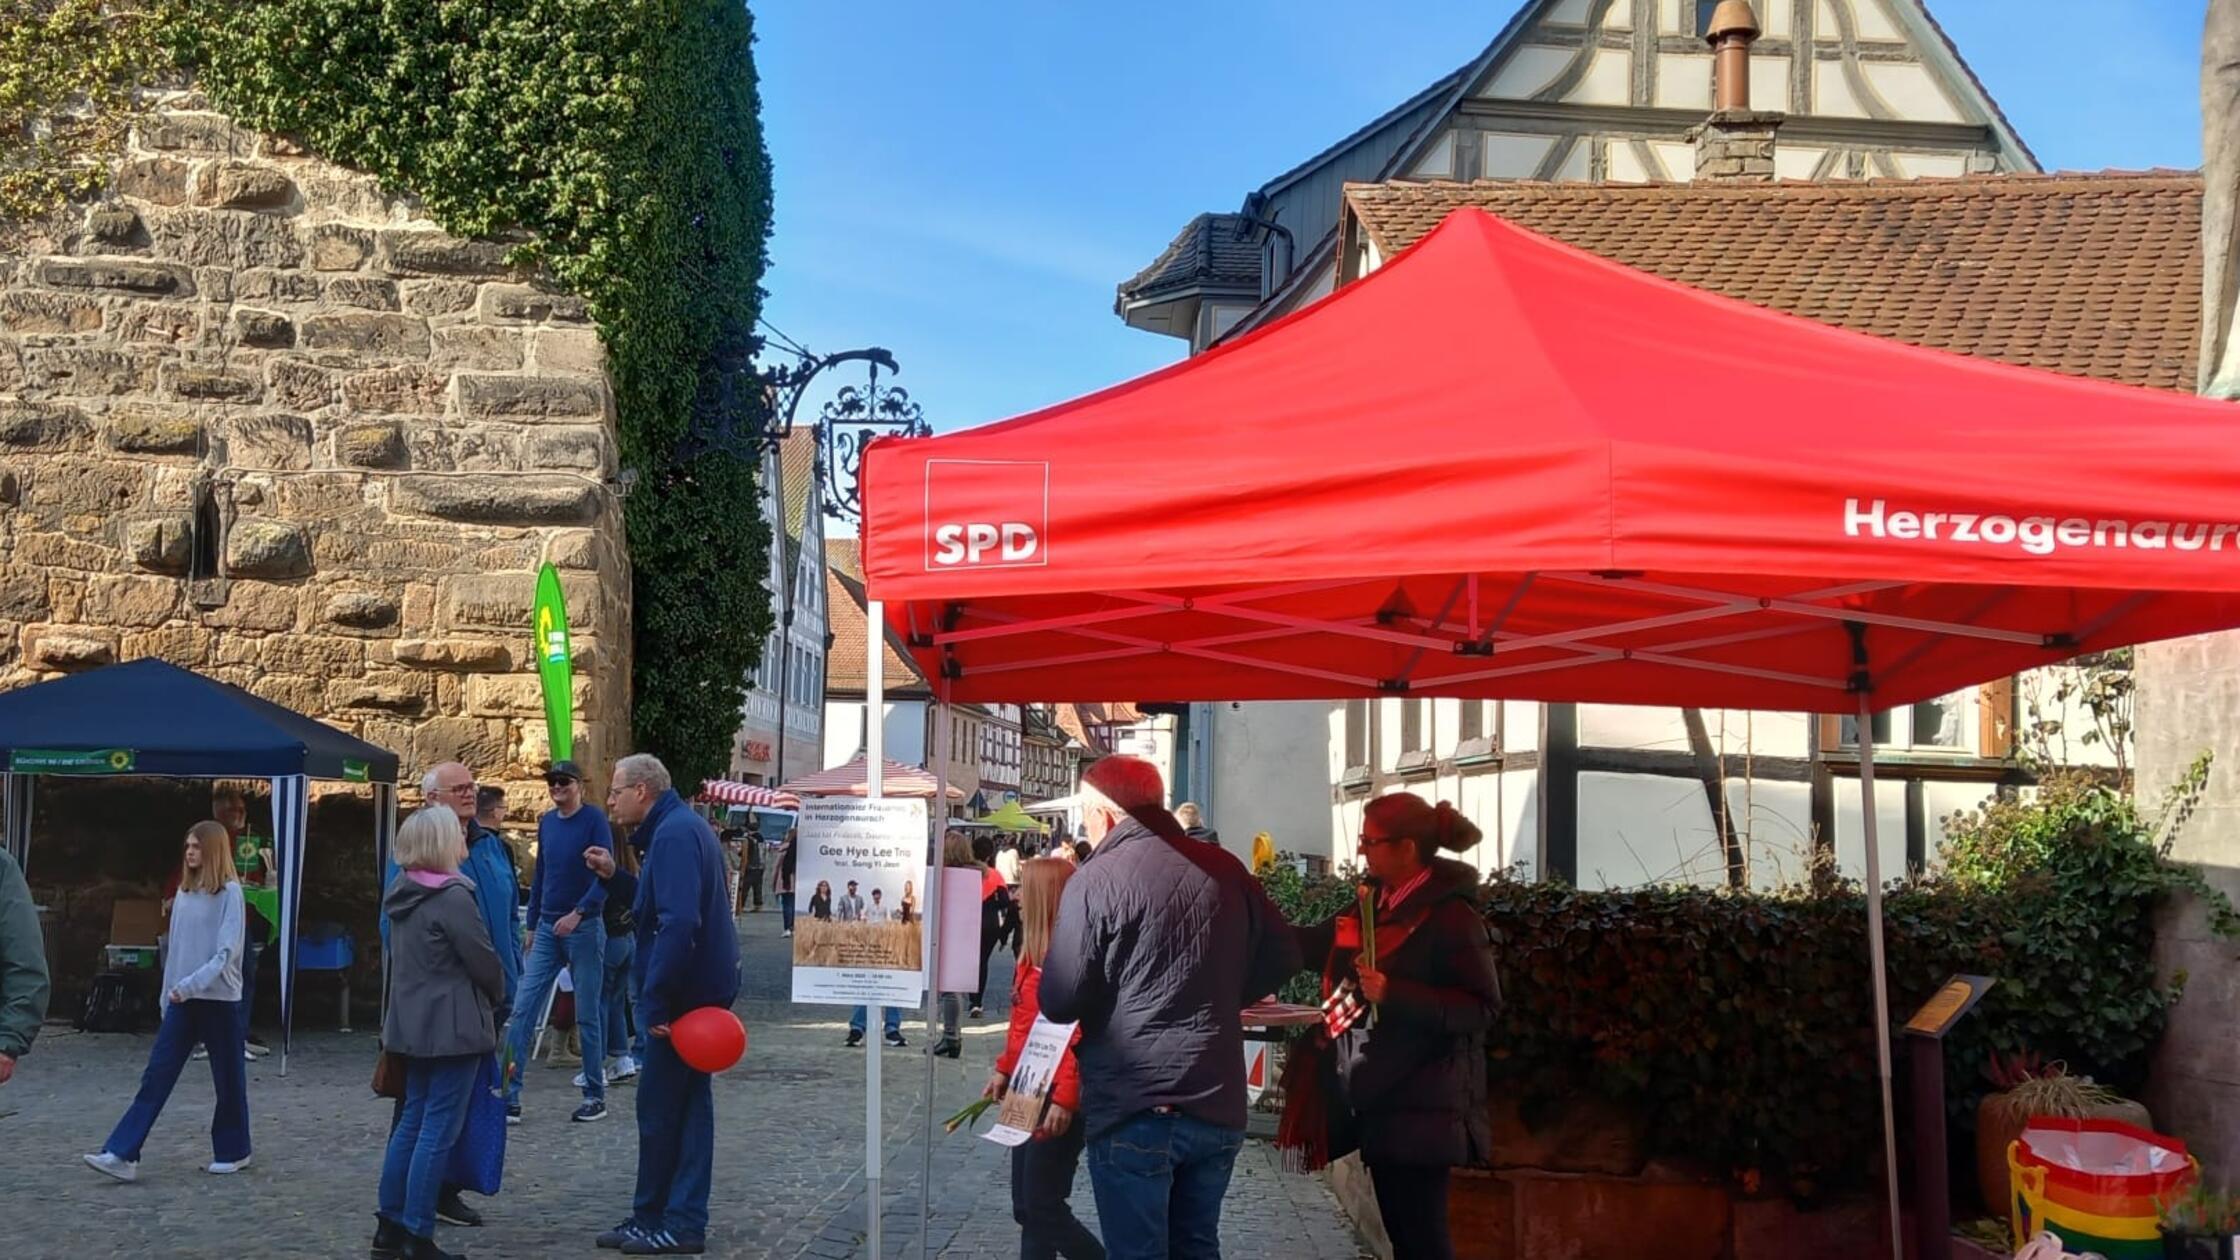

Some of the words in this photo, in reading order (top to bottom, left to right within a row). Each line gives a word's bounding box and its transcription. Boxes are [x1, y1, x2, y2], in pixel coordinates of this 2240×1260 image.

[1844, 498, 2240, 555] Herzogenaur
[934, 523, 1038, 565] SPD
[804, 813, 813, 821] in
[815, 813, 885, 823] Herzogenaurach
[819, 844, 843, 856] Gee
[846, 845, 869, 859] Hye
[872, 846, 893, 857] Lee
